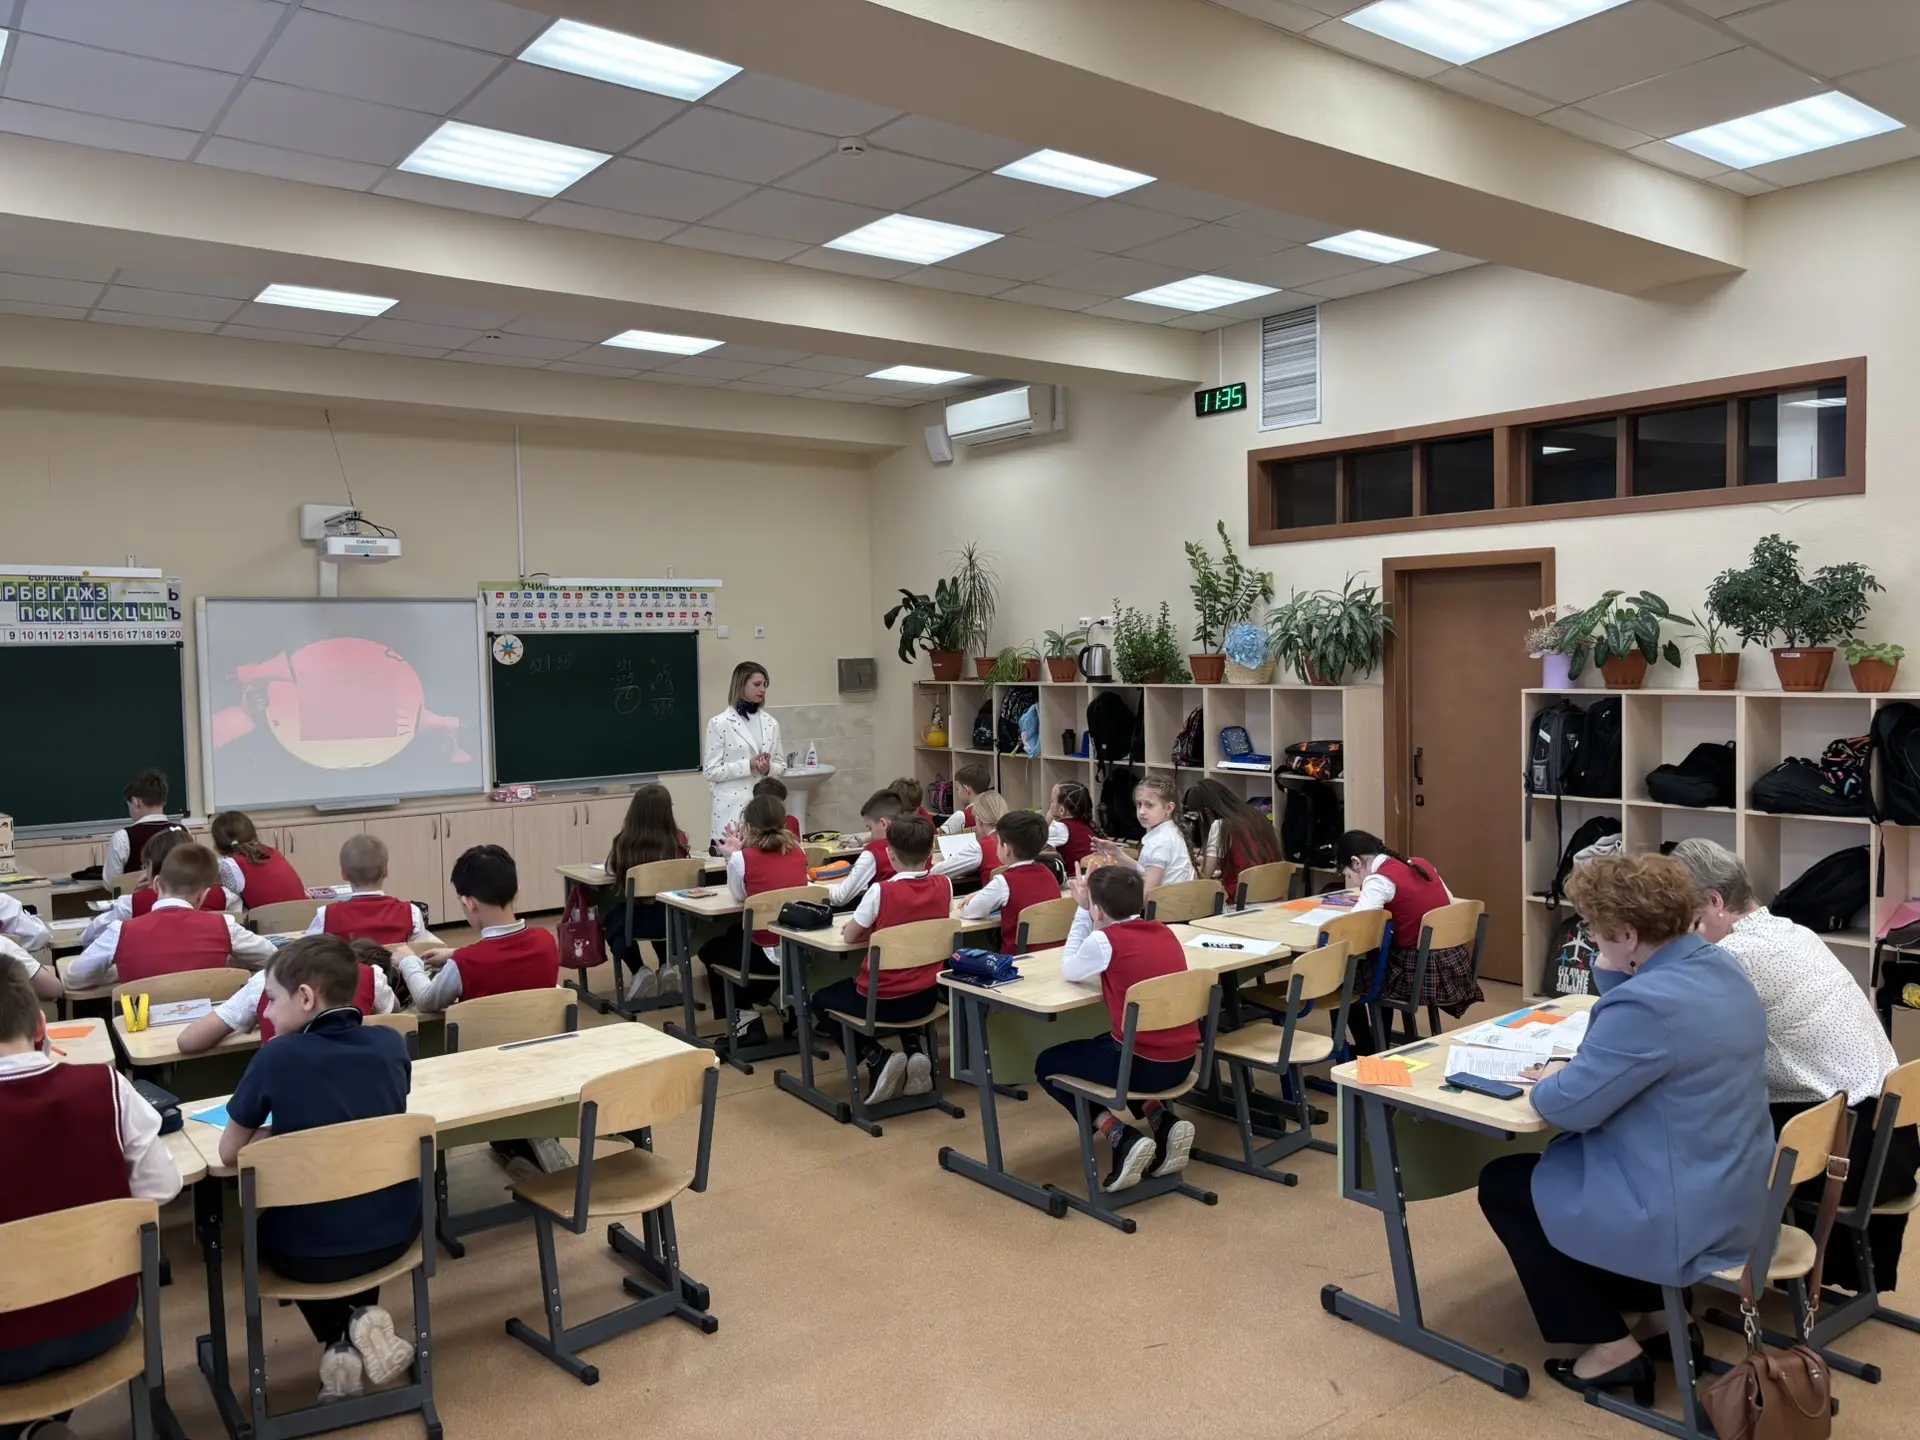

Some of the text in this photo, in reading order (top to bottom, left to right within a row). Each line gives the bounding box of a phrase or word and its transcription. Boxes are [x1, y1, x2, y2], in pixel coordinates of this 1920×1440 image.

[1204, 385, 1242, 412] 11:35
[9, 629, 181, 640] 9 10 11 12 13 14 15 16 17 18 19 20
[1558, 974, 1589, 988] TO THE
